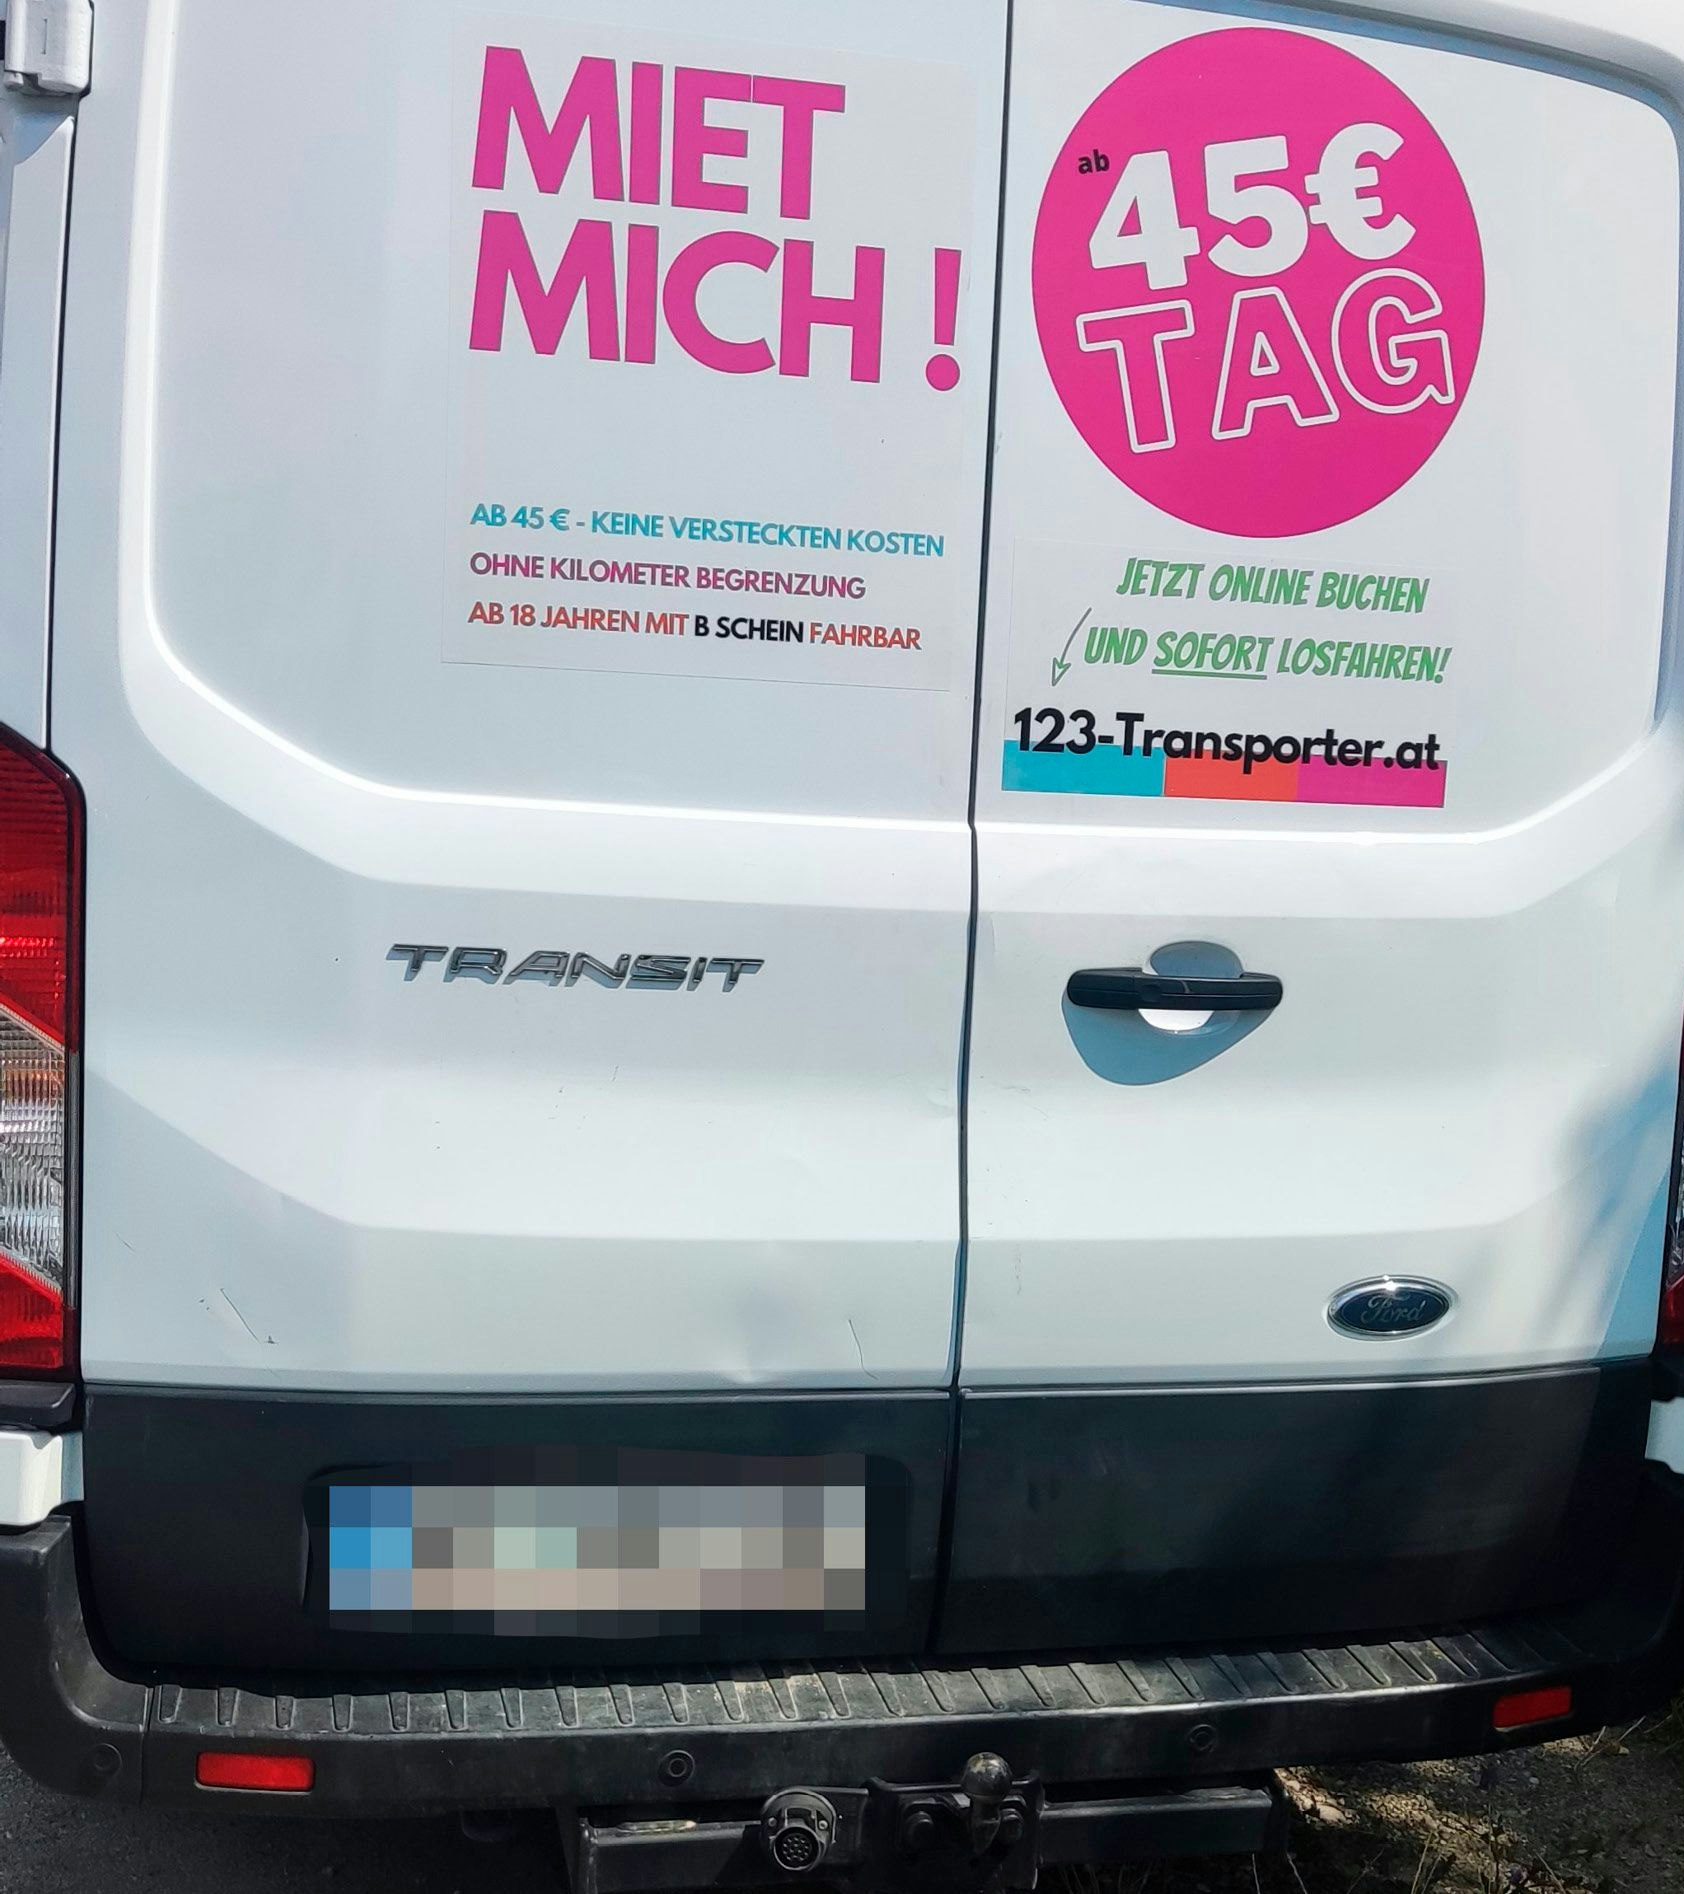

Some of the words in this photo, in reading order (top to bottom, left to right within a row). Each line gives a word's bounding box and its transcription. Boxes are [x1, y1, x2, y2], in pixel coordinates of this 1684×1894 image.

[472, 45, 846, 220] MIET
[1077, 149, 1110, 174] ab
[1088, 121, 1417, 291] 45€
[469, 209, 886, 384] MICH
[925, 246, 962, 391] !
[1075, 267, 1456, 454] TAG
[469, 502, 507, 526] AB
[511, 505, 544, 530] 45
[549, 508, 570, 531] €
[591, 510, 664, 538] KEINE
[668, 516, 842, 551] VERSTECKTEN
[846, 528, 945, 557] KOSTEN
[469, 551, 545, 579] OHNE
[549, 556, 692, 588] KILOMETER
[696, 566, 867, 600] BEGRENZUNG
[1115, 557, 1206, 600] JETZT
[1208, 563, 1314, 607] ONLINE
[1315, 571, 1430, 614] BUCHEN
[467, 601, 504, 625] AB
[509, 603, 536, 627] 18
[540, 606, 640, 633] JAHREN
[645, 612, 690, 636] MIT
[694, 615, 710, 637] B
[714, 616, 804, 643] SCHEIN
[809, 621, 923, 651] FAHRBAR
[1083, 626, 1148, 666] UND
[1153, 630, 1274, 675] SOFORT
[1276, 637, 1453, 684] LOSFAHREN!
[1013, 706, 1441, 775] 123-Transporter.at
[386, 943, 766, 990] TRANSIT
[1361, 1294, 1427, 1324] Ford
